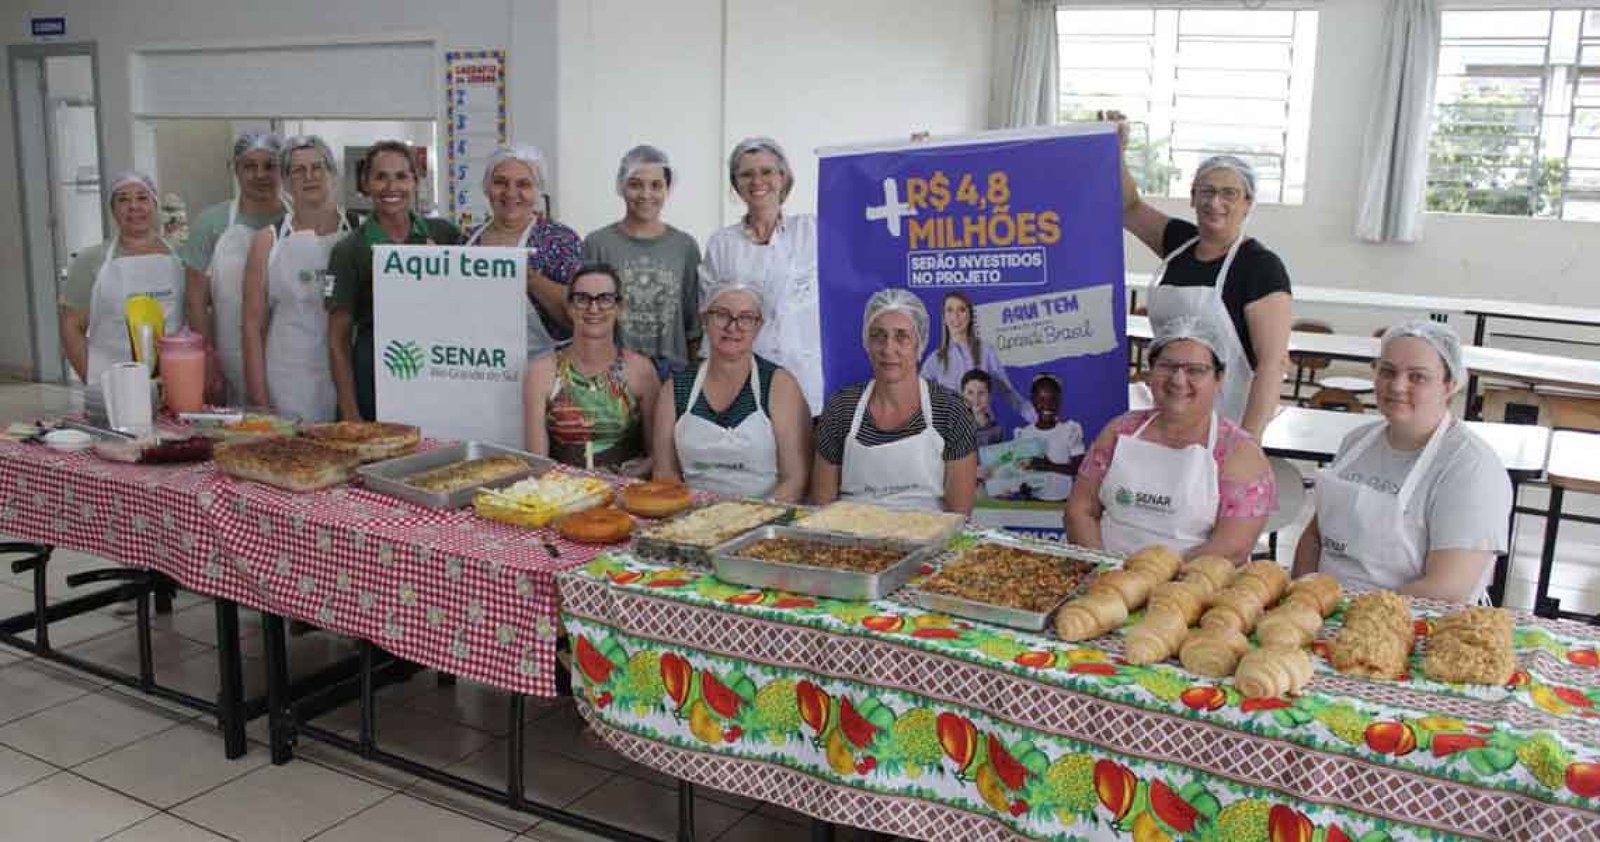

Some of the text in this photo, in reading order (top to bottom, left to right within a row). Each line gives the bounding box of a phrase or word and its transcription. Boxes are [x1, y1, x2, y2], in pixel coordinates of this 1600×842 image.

[906, 170, 950, 212] R$
[956, 171, 1011, 210] 4,8
[908, 205, 1062, 249] MILHÕES
[383, 250, 517, 281] Aqui tem
[911, 252, 1042, 270] SERÃO INVESTIDOS
[912, 270, 1001, 284] NO PROJETO
[1002, 294, 1079, 324] AQUI TEM
[430, 344, 507, 368] SENAR
[1135, 492, 1171, 507] SENAR
